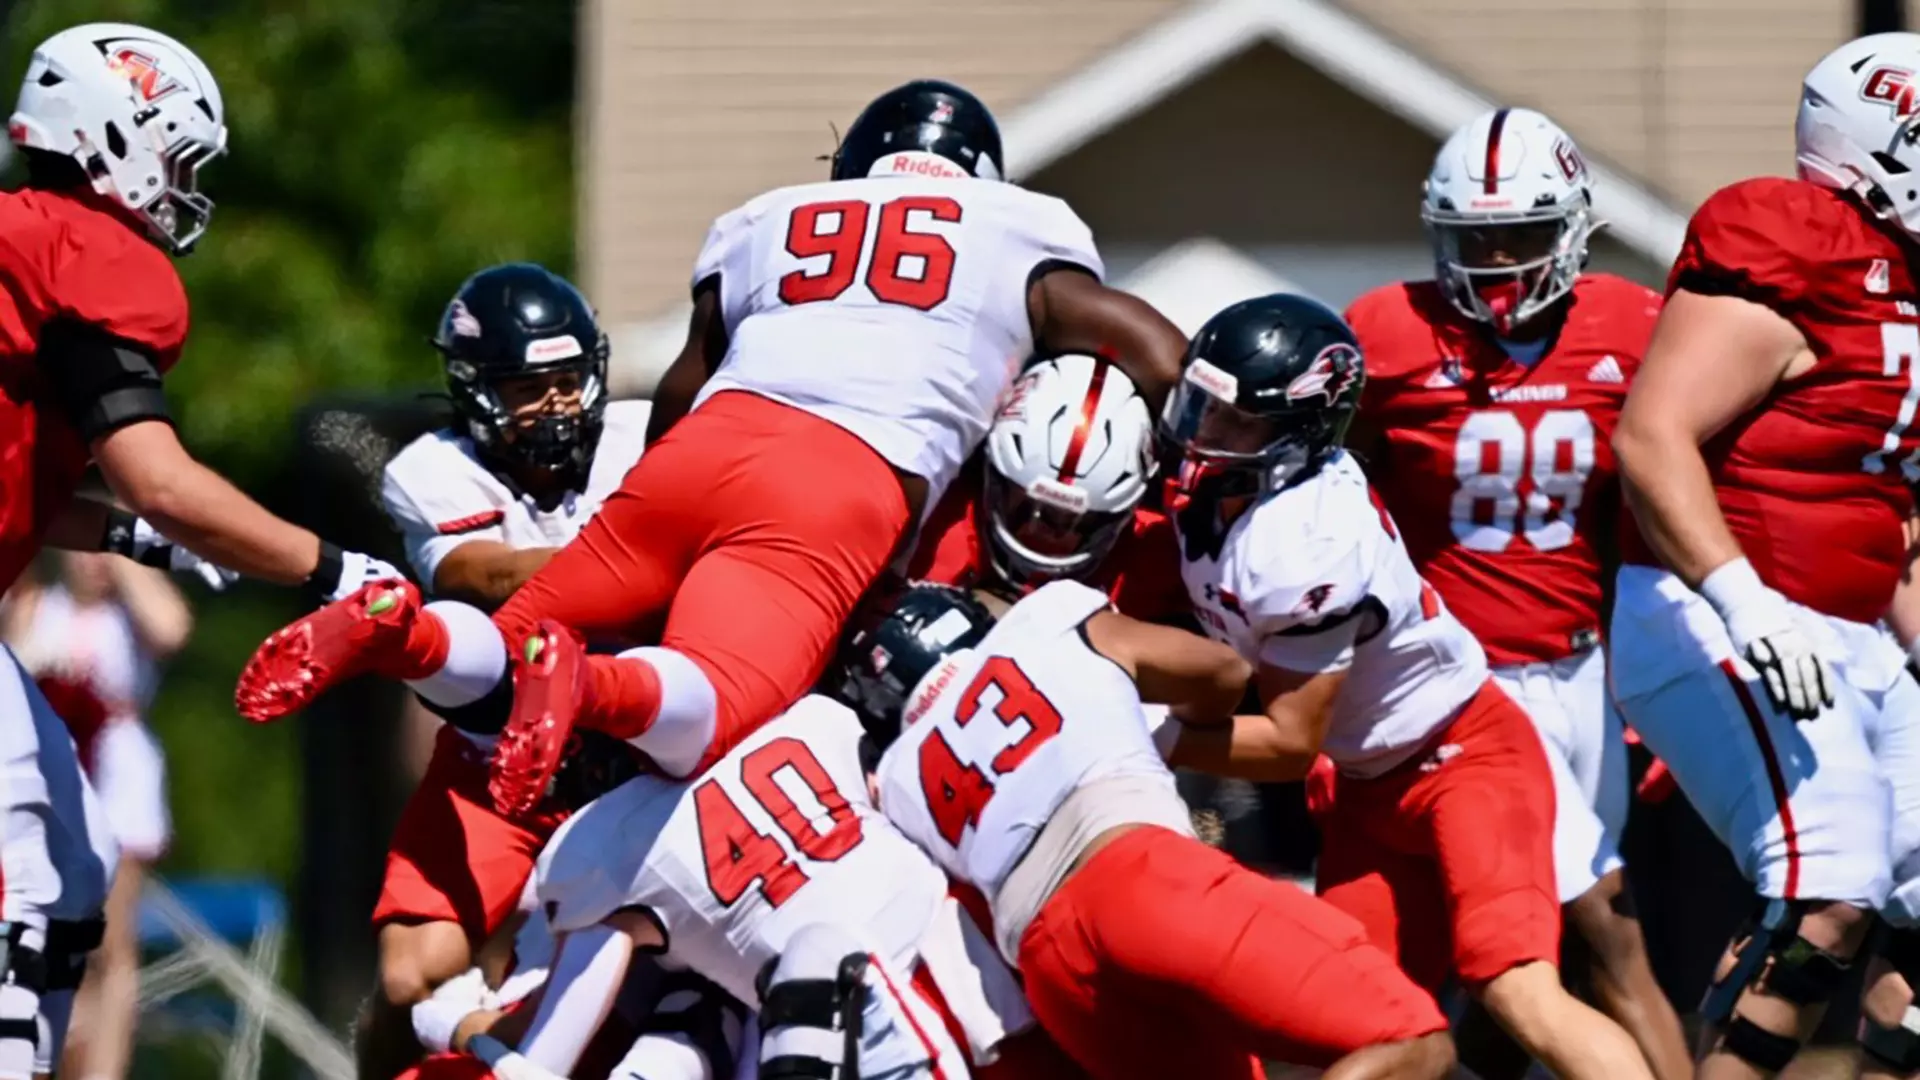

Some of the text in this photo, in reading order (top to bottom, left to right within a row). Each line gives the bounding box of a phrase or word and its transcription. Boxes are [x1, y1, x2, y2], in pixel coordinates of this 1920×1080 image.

[778, 196, 963, 312] 96
[1450, 408, 1596, 554] 88
[1861, 321, 1920, 483] 7
[693, 736, 865, 910] 40
[918, 655, 1064, 850] 43
